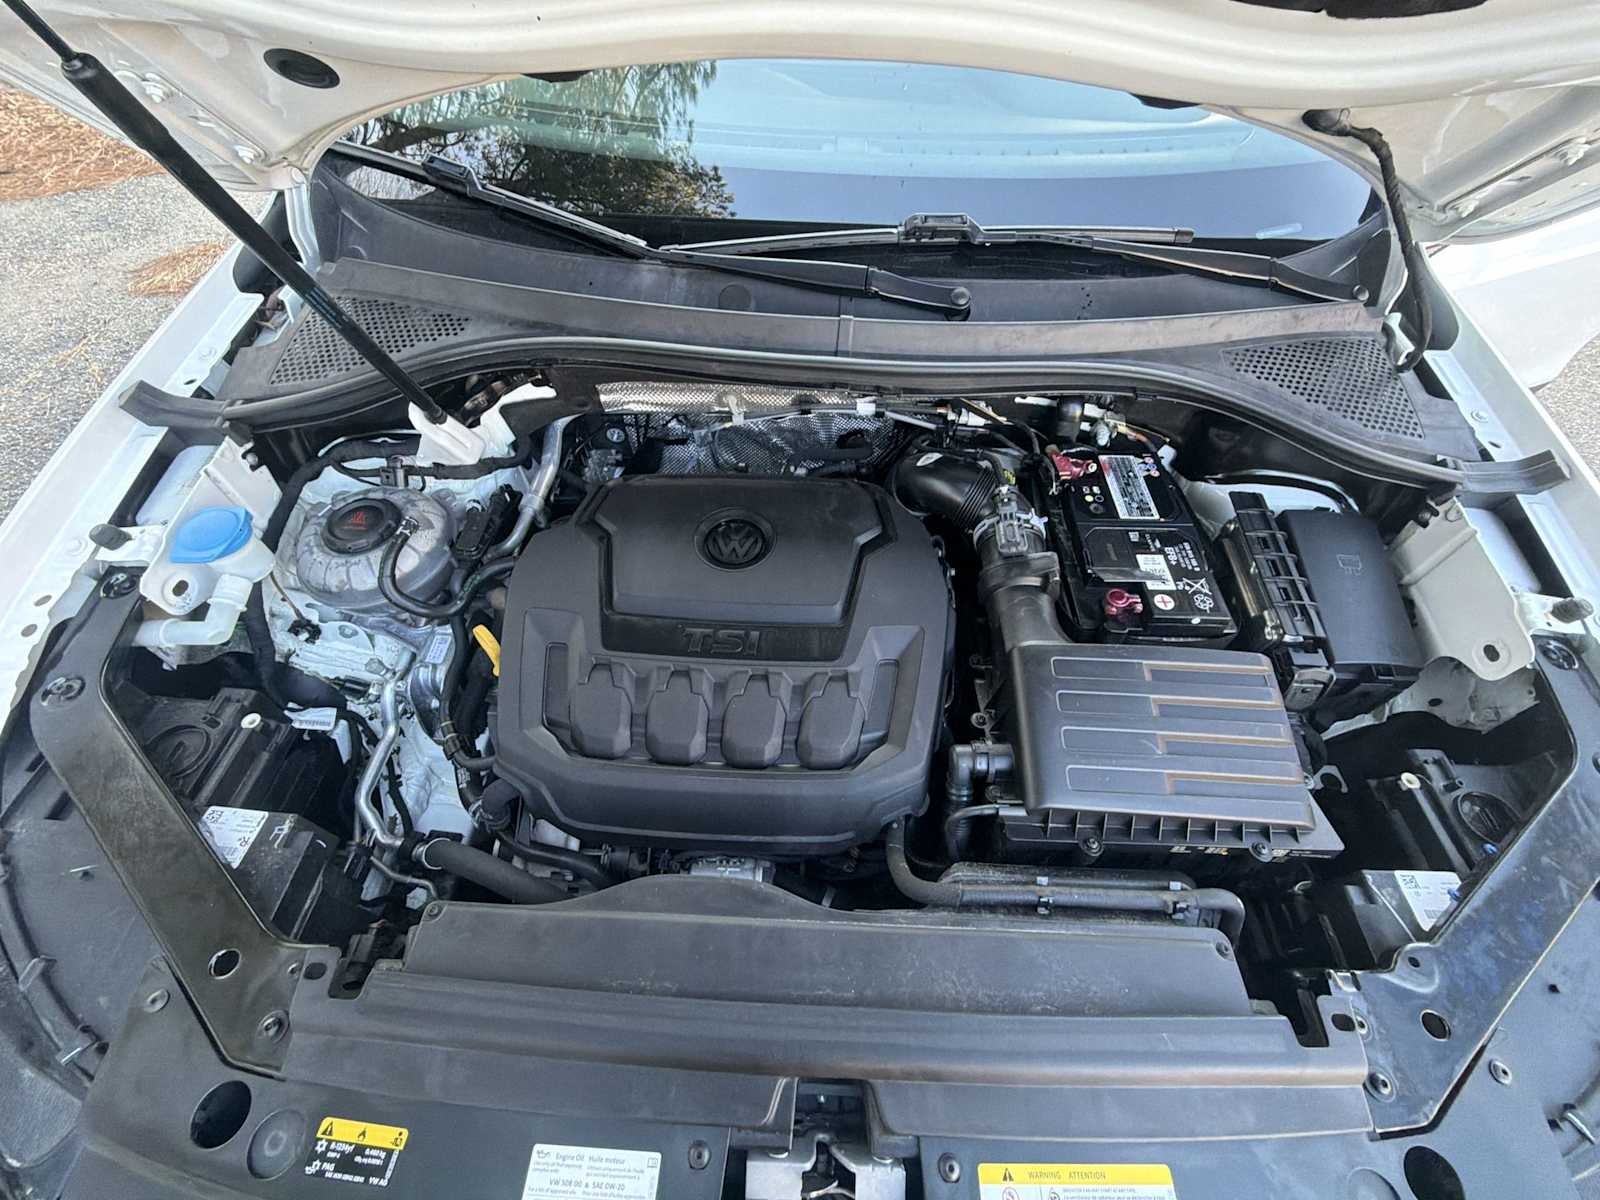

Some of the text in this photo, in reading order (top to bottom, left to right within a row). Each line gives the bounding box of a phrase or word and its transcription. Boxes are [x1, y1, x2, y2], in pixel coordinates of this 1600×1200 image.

[683, 627, 761, 657] TSI
[555, 1152, 575, 1162] Engine
[322, 1162, 335, 1171] PAG
[1027, 1171, 1107, 1180] WARNING ATTENTION
[549, 1176, 561, 1186] VW
